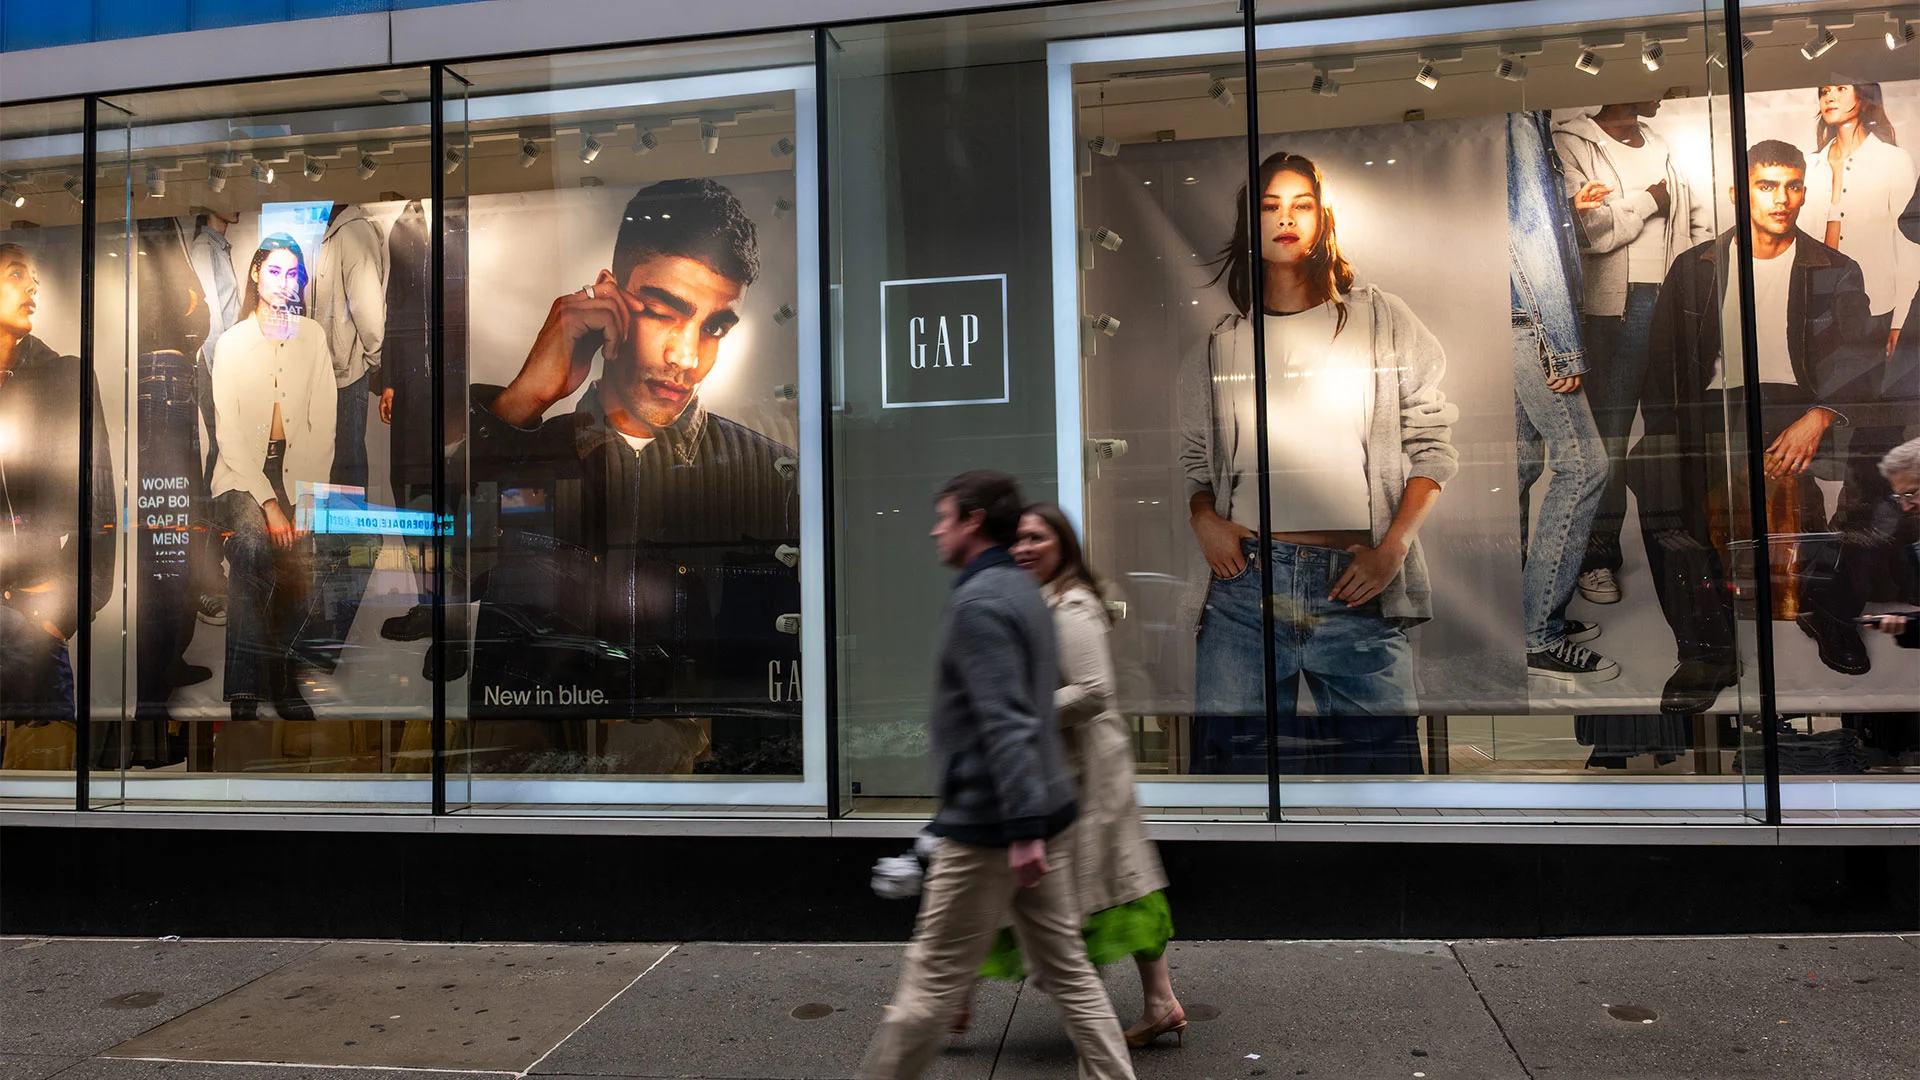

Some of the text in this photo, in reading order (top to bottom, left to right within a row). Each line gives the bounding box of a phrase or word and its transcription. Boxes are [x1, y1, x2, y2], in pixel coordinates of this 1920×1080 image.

[909, 314, 979, 369] GAP
[138, 495, 190, 508] GAP BO
[146, 514, 173, 527] GAP
[152, 532, 190, 545] MENS
[768, 659, 802, 703] GA
[484, 684, 609, 706] New in blue.
